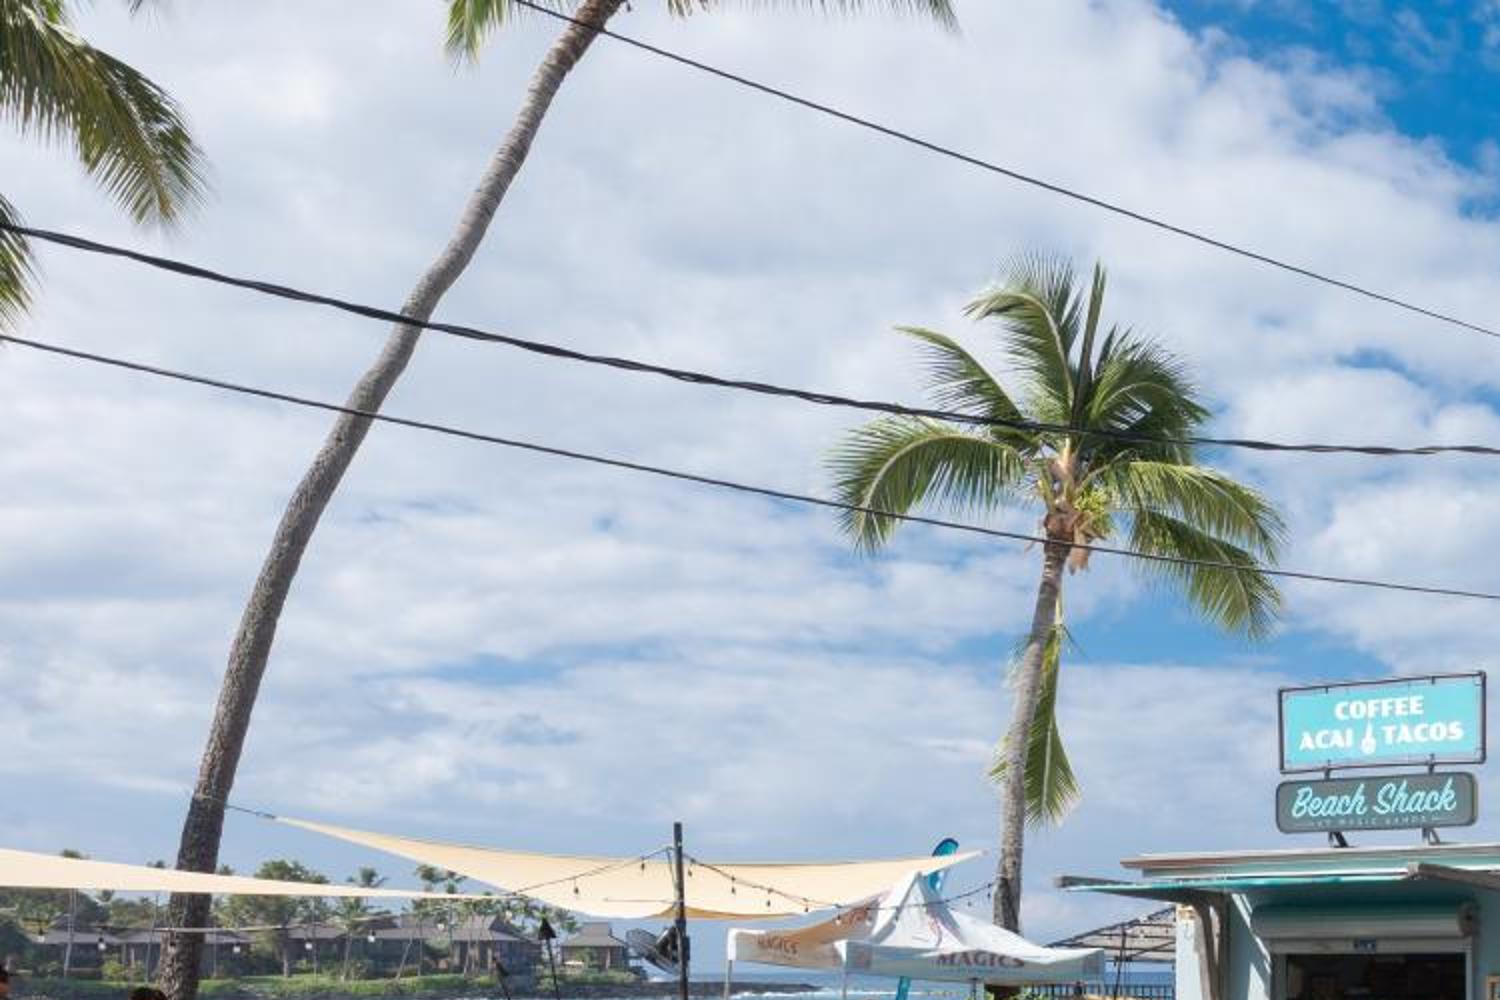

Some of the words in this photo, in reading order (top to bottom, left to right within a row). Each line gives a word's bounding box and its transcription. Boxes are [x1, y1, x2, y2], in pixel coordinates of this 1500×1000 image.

[1335, 696, 1424, 721] COFFEE
[1299, 729, 1353, 750] ACAI
[1382, 721, 1464, 745] TACOS
[1292, 783, 1368, 818] Beach
[1373, 778, 1457, 815] Shack
